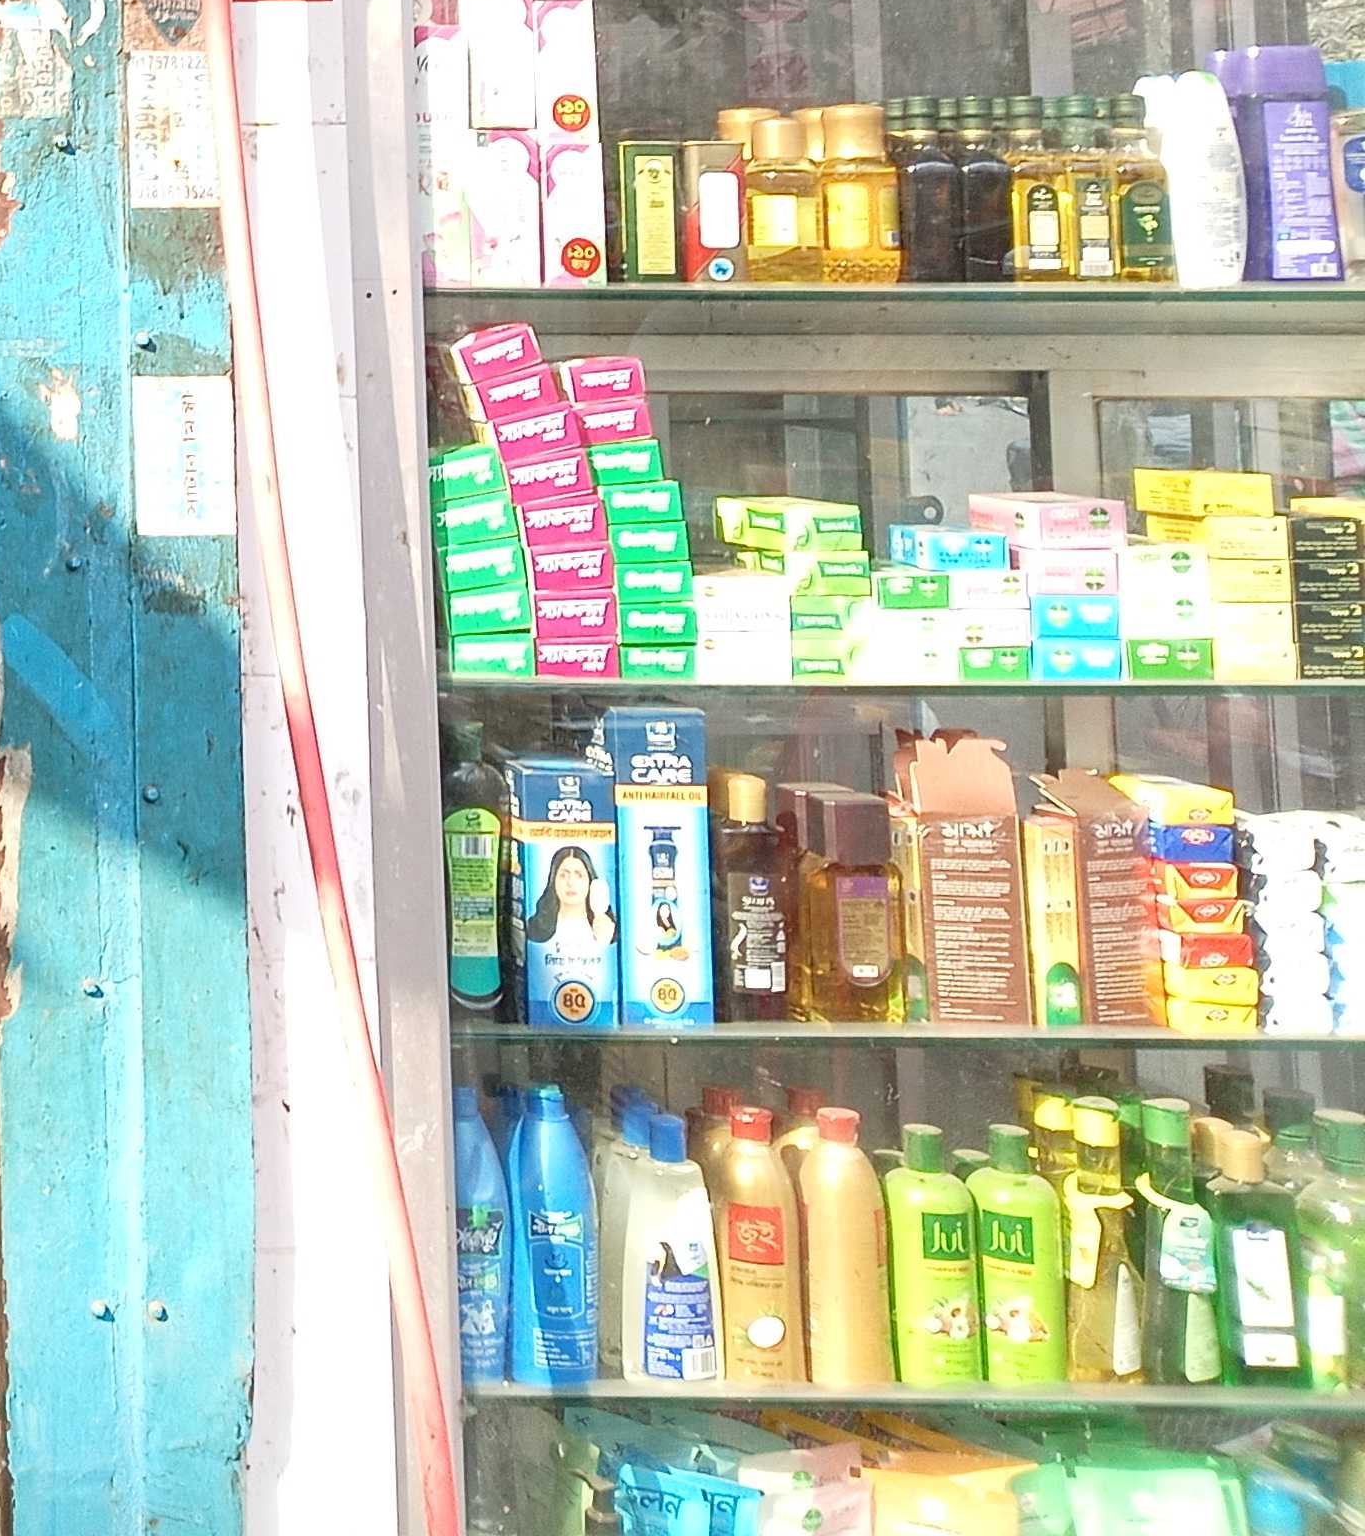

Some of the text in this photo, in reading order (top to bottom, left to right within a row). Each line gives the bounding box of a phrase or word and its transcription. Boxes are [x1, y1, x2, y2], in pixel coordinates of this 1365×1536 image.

[631, 753, 694, 769] EXTRA
[631, 768, 694, 784] CARE
[622, 791, 643, 800] ANTI
[688, 791, 703, 800] OIL
[547, 798, 593, 811] EXTRA
[547, 810, 593, 822] CARE
[931, 1219, 966, 1254] Jui
[989, 1219, 1032, 1257] Jui
